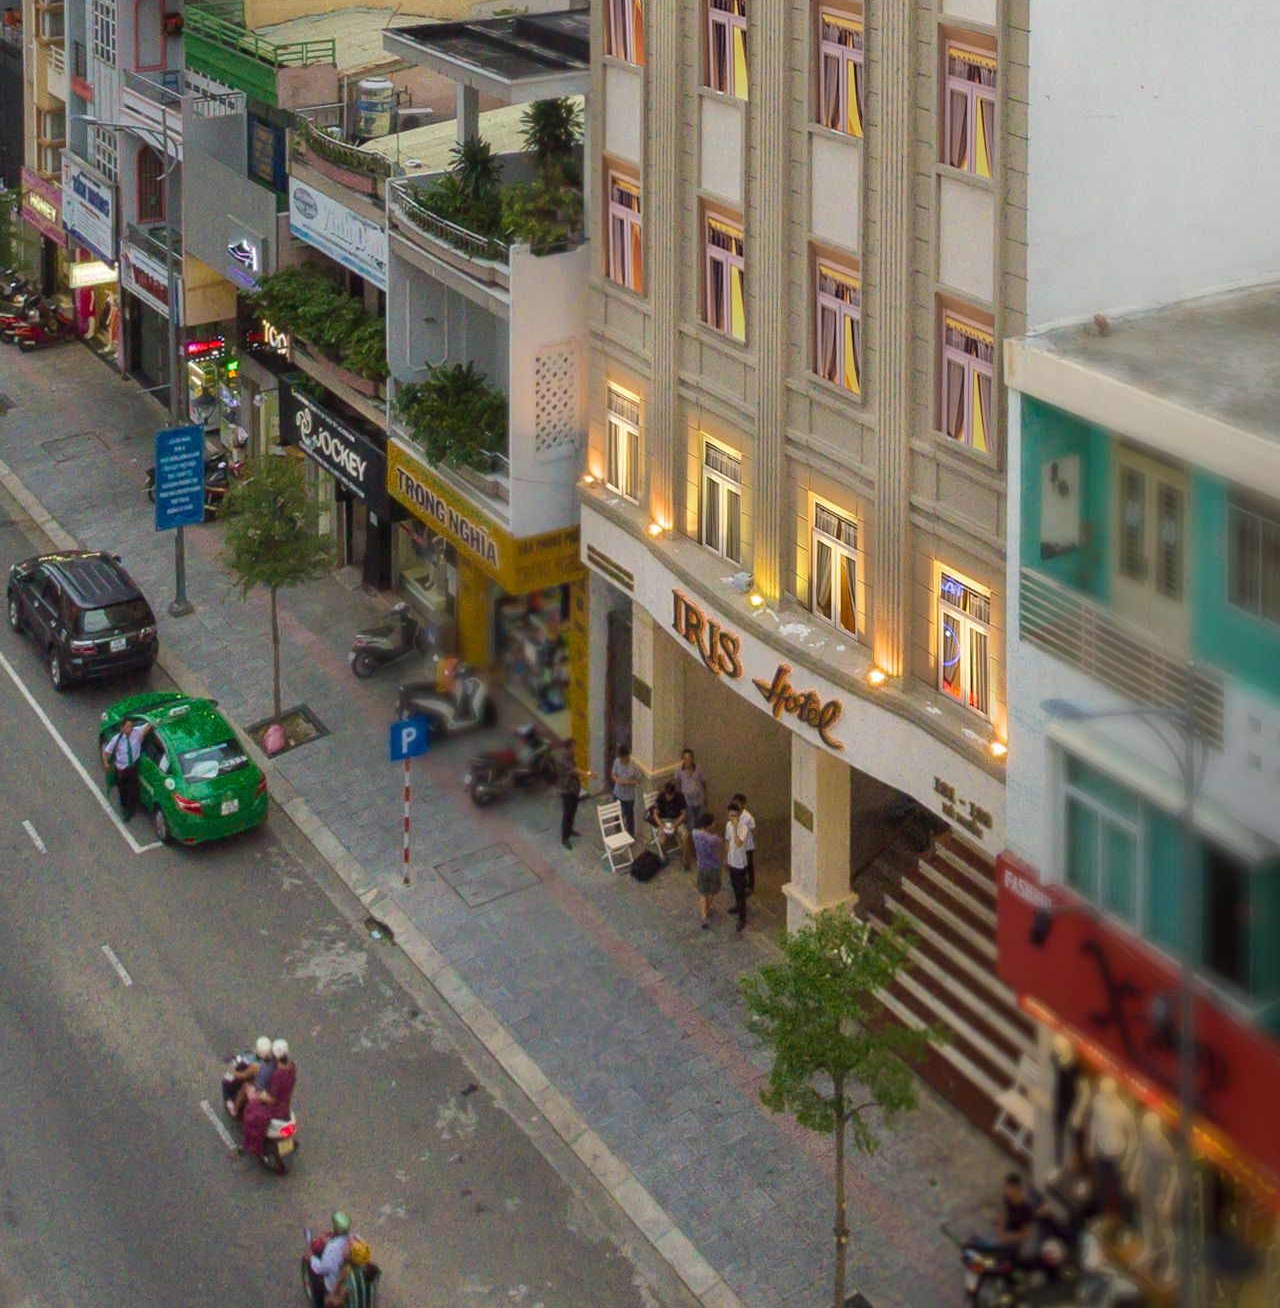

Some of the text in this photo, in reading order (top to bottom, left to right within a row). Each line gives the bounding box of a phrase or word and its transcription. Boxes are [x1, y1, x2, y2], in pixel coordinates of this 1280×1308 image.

[316, 427, 367, 482] JOCKEY
[671, 588, 847, 750] IRIS Hotel
[401, 726, 417, 754] P
